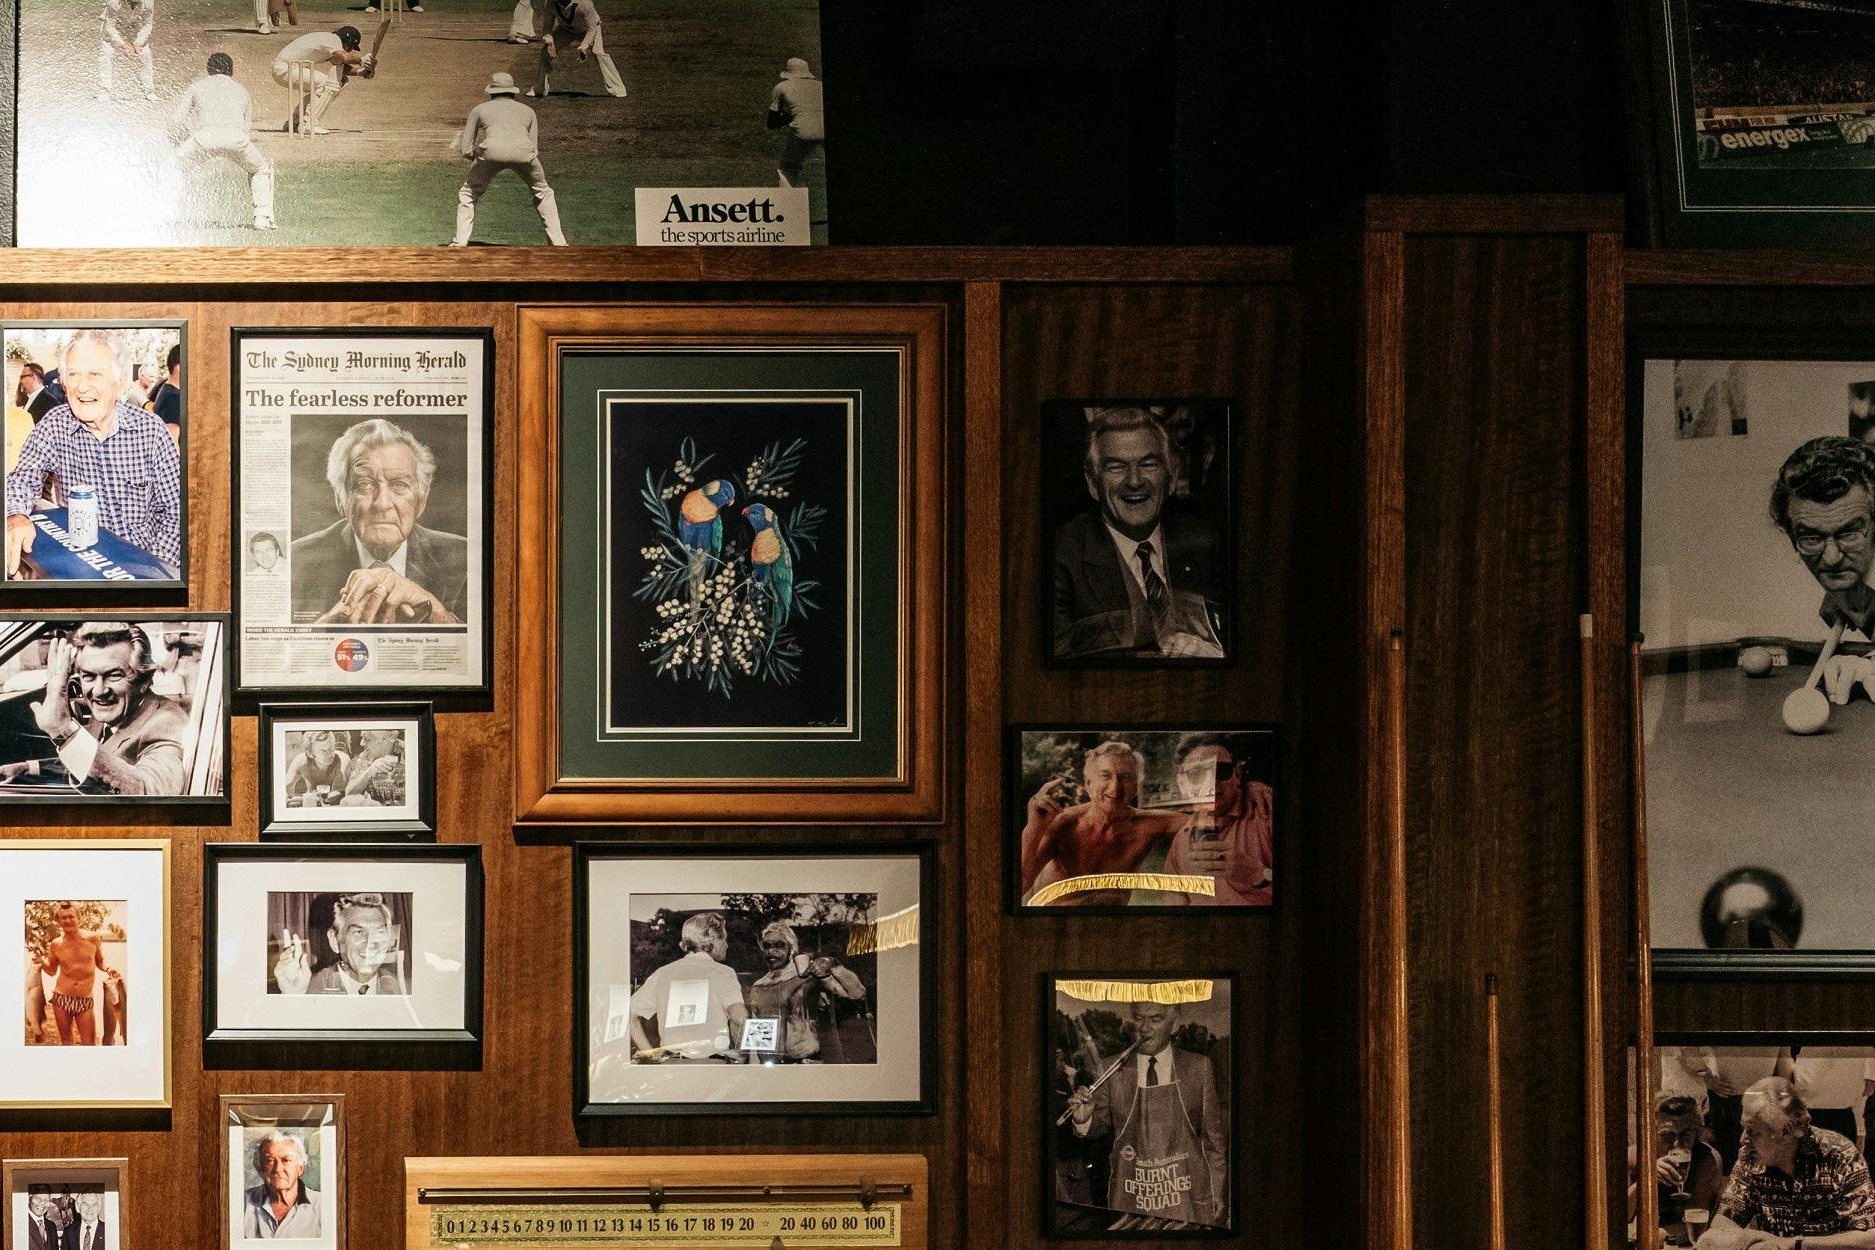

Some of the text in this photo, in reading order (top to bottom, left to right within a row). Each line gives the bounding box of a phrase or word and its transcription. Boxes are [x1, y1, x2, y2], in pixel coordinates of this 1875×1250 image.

[1720, 128, 1811, 149] energex
[661, 193, 785, 223] Ansett.
[661, 228, 785, 246] the sports airline
[246, 350, 467, 374] The Sydney Morning Herald
[245, 388, 468, 407] The fearless reformer
[1135, 1164, 1179, 1183] BURNT
[1125, 1175, 1192, 1197] OFFERINGS
[1136, 1192, 1181, 1212] SQUAD
[447, 1217, 886, 1233] 0 1 2 3 4 5 6 7 8 9 10 11 12 13 14 15 16 17 18 19 20 20 40 60 80 100
